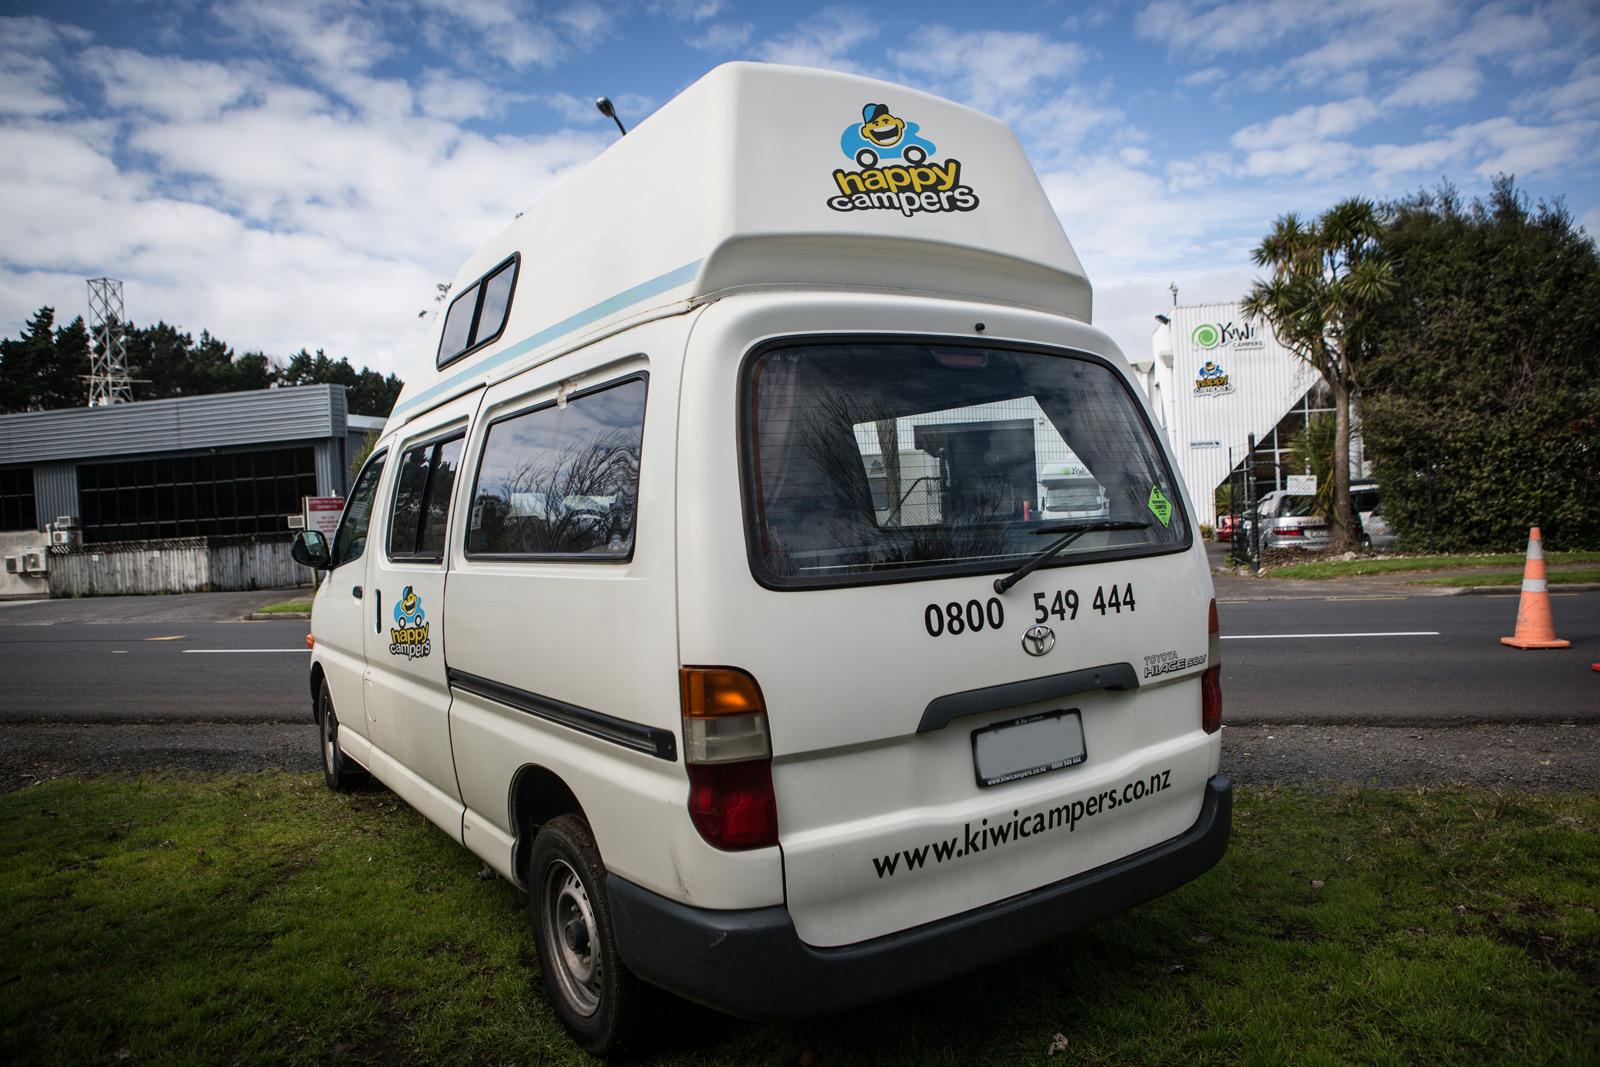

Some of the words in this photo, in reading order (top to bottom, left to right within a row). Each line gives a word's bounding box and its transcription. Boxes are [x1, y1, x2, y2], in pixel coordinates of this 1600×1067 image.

[832, 159, 961, 195] happy
[827, 186, 979, 217] campers
[1194, 383, 1233, 395] campers
[1196, 374, 1228, 389] happy
[925, 597, 1004, 637] 0800
[1033, 589, 1079, 624] 549
[1092, 583, 1135, 616] 444
[391, 621, 429, 645] happy
[389, 639, 431, 661] campers
[1144, 650, 1178, 665] TOYOTA
[1144, 658, 1186, 679] HIACE
[987, 766, 1047, 785] www.kiwicampers.co.nz
[872, 769, 1171, 879] www.kiwicampers.co.nz
